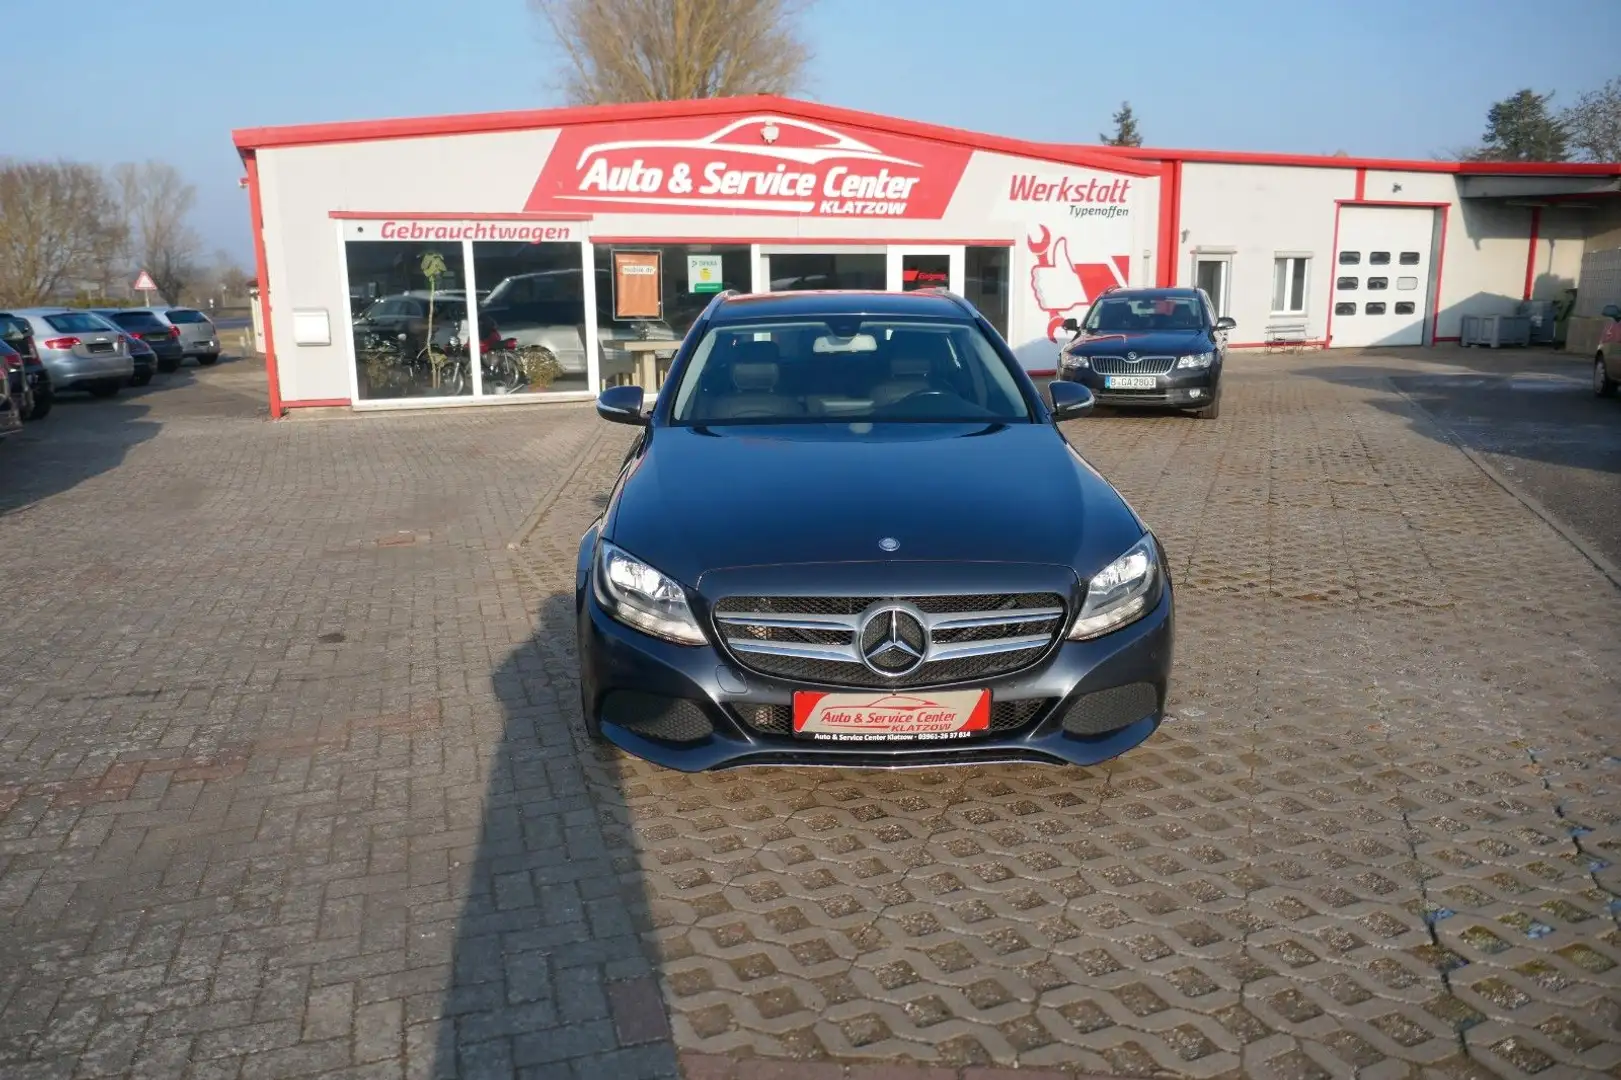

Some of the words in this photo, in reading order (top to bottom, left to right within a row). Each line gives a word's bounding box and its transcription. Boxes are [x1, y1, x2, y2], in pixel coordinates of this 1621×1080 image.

[579, 158, 663, 193] Auto
[668, 162, 692, 194] &
[699, 162, 817, 196] Service
[823, 166, 920, 199] Center
[1009, 175, 1132, 203] Werkstatt
[820, 200, 907, 215] KLATZOW
[1069, 205, 1129, 218] Typenoffen
[380, 221, 570, 244] Gebrauchtwagen
[821, 711, 852, 723] Auto
[853, 711, 863, 723] &
[866, 711, 913, 723] Service
[917, 711, 957, 723] Center
[891, 723, 952, 732] KLATZOW
[887, 733, 913, 741] Klatzow
